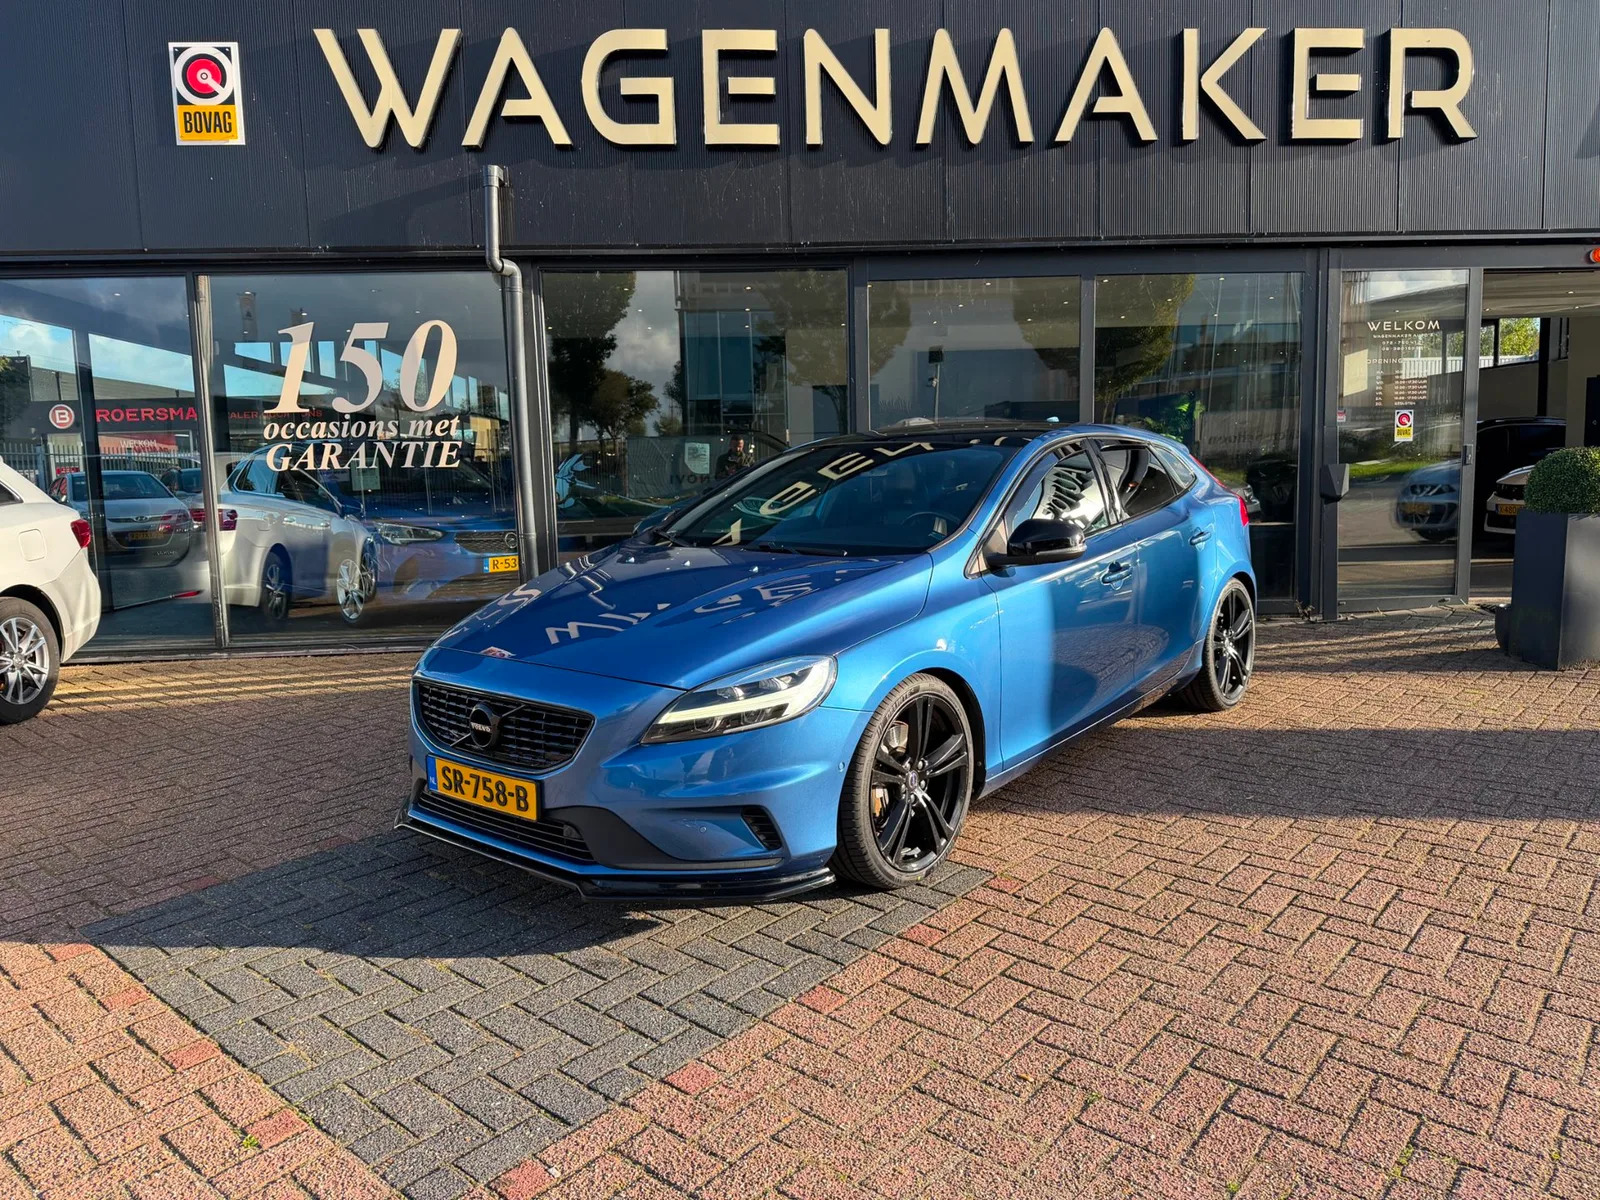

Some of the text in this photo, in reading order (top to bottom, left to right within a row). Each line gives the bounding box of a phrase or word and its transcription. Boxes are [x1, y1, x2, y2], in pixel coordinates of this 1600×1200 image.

[313, 27, 1477, 148] WAGENMAKER
[183, 111, 232, 133] BOVAG
[1367, 320, 1440, 331] WELKOM
[264, 320, 458, 414] 150
[54, 409, 69, 424] B
[263, 414, 461, 440] occasions met
[266, 441, 463, 472] GARANTIE
[470, 722, 491, 733] VOLVO
[441, 765, 529, 813] SR-758-B
